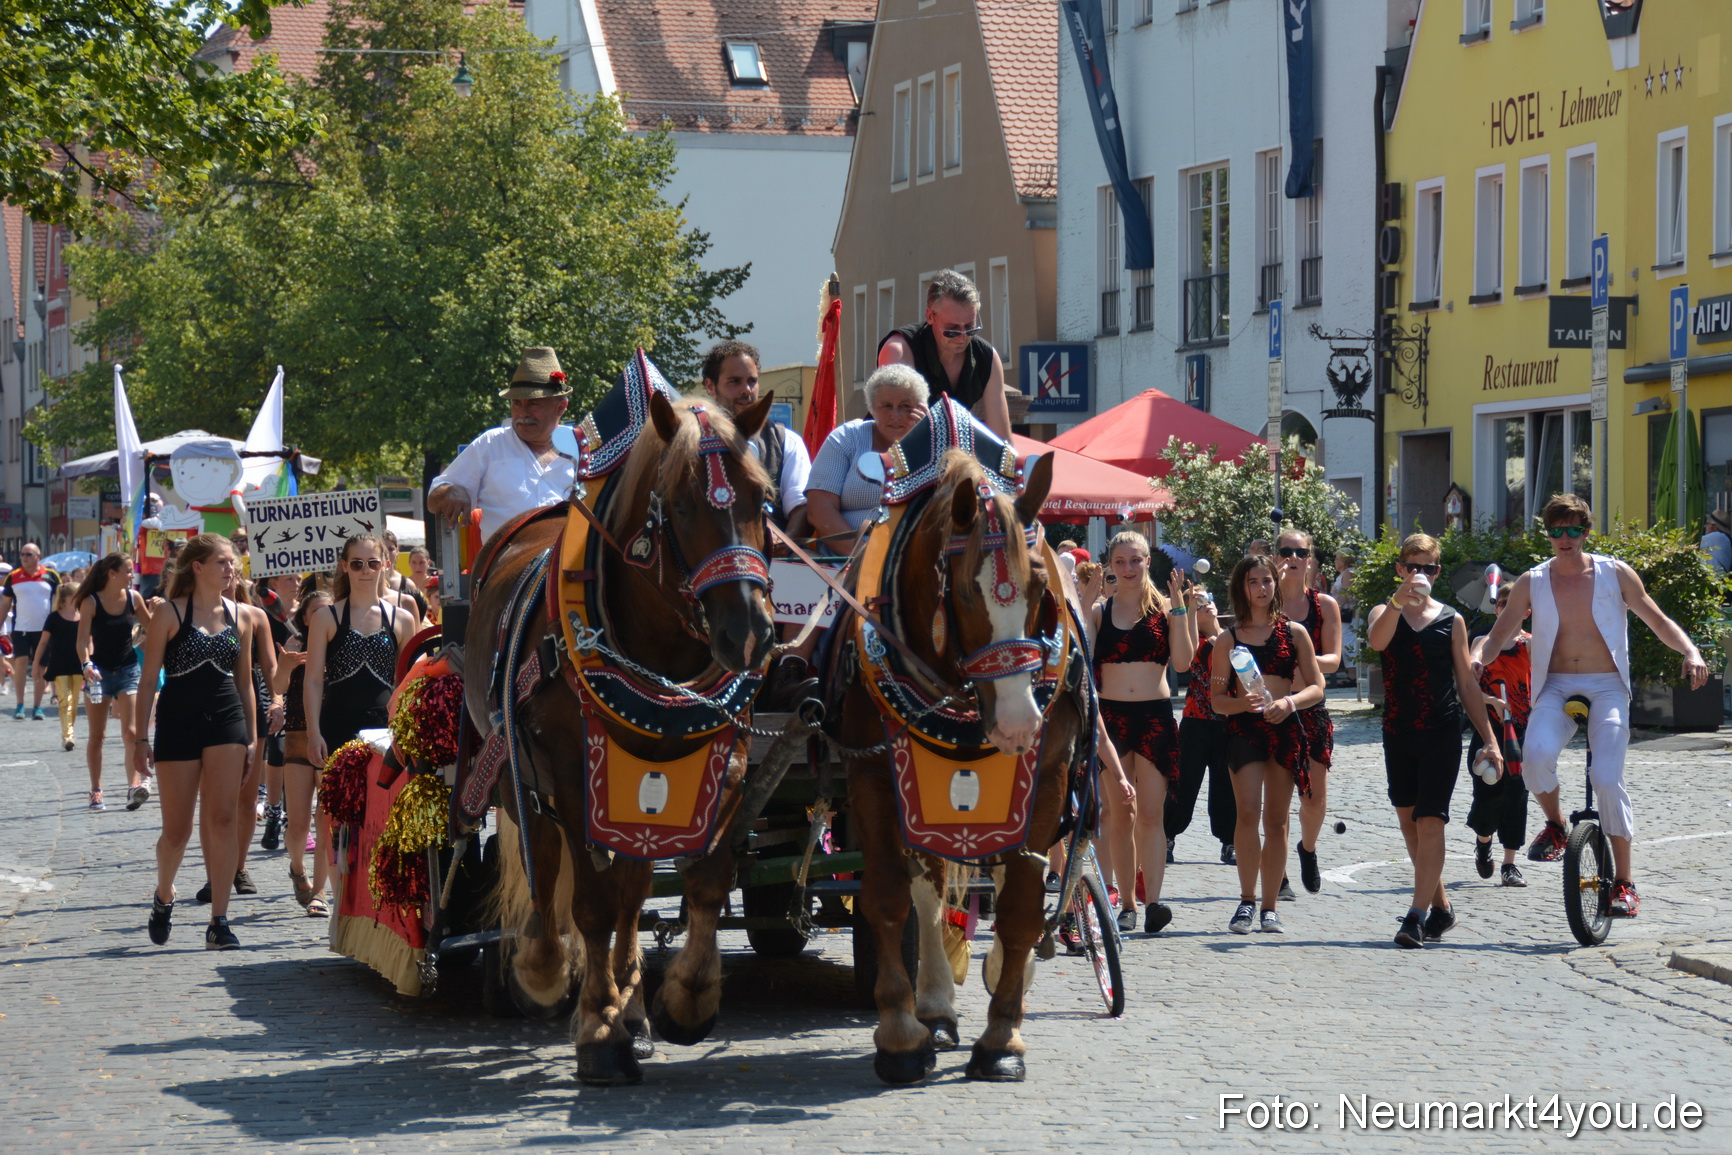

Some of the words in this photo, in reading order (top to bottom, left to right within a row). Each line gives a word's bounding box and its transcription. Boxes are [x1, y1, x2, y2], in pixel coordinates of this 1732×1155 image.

[1491, 91, 1544, 149] HOTEL
[1559, 79, 1622, 128] Lehmeier
[1379, 182, 1401, 394] HOTEL
[1594, 247, 1605, 299] P
[1271, 308, 1279, 351] P
[1554, 329, 1622, 341] TAIFN
[1673, 297, 1684, 351] P
[1688, 300, 1732, 335] TAIFU
[1482, 352, 1559, 391] Restaurant
[1045, 398, 1080, 406] RUPPERT
[248, 496, 378, 523] TURNABTEILUNG
[1042, 499, 1062, 510] otel
[1064, 500, 1122, 510] Restaurant
